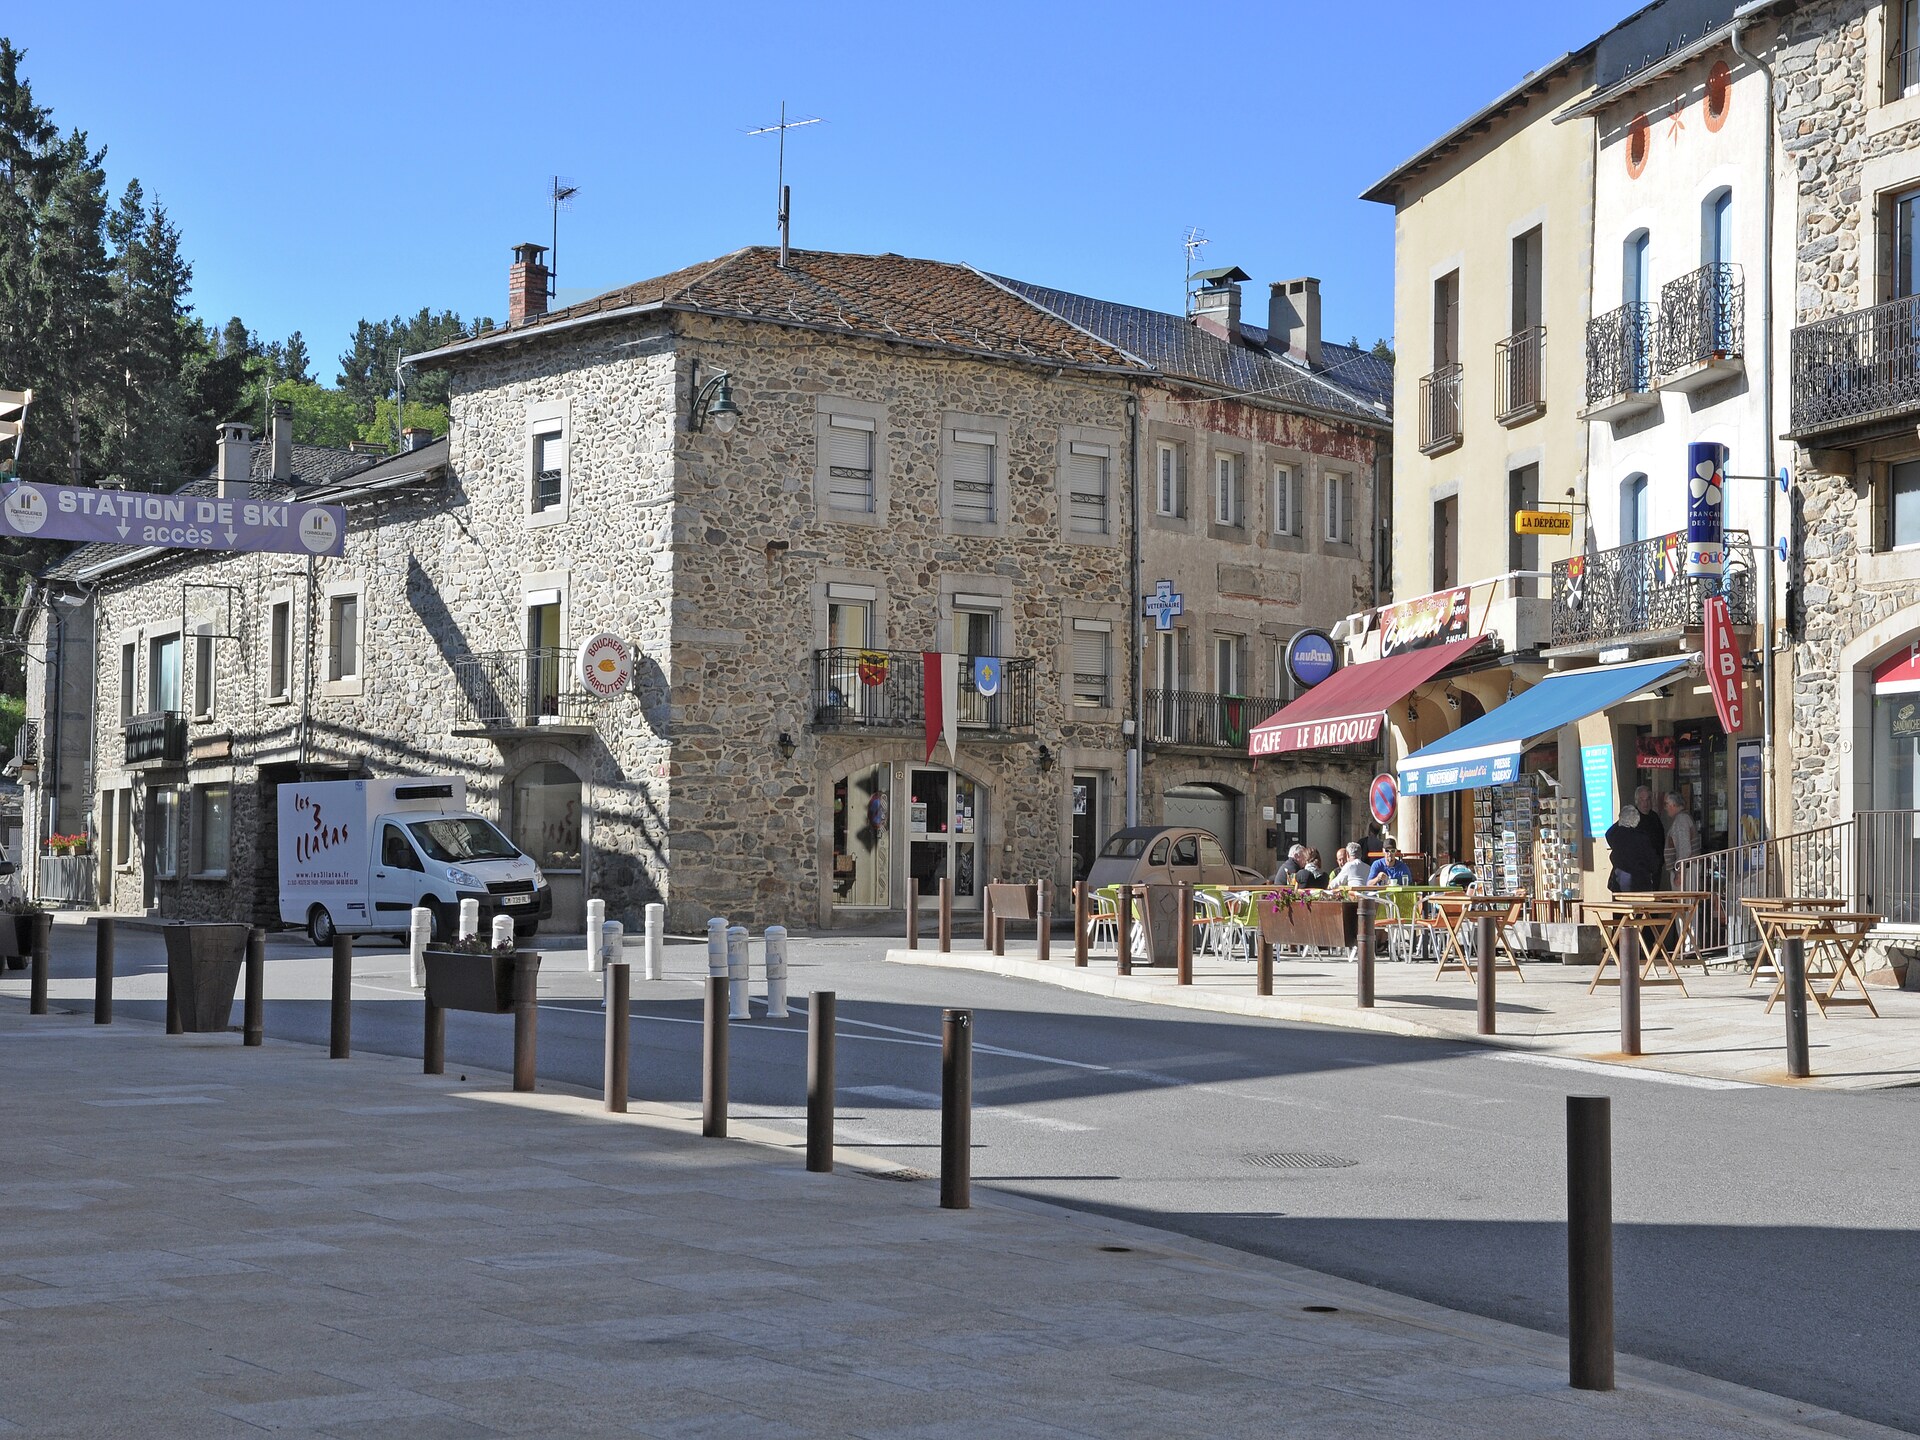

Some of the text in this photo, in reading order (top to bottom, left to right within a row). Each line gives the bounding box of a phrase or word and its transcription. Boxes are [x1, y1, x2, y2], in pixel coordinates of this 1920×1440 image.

[58, 490, 289, 527] STATION DE SKI
[1521, 515, 1571, 529] LA DÉPÊCHE
[142, 524, 213, 545] accès
[587, 637, 628, 662] BOUCHERIE
[1294, 649, 1332, 662] LAVAZZA
[1713, 600, 1742, 728] TABAC
[585, 664, 628, 694] CHARCUTERIE
[1253, 718, 1377, 753] CAFE LE BAROQUE
[1493, 757, 1512, 769] PRESSE
[1643, 756, 1673, 765] L'ÉQUIPE
[1406, 771, 1420, 782] TABAC
[295, 793, 310, 812] les
[312, 803, 322, 831] 3
[296, 824, 349, 864] llatas
